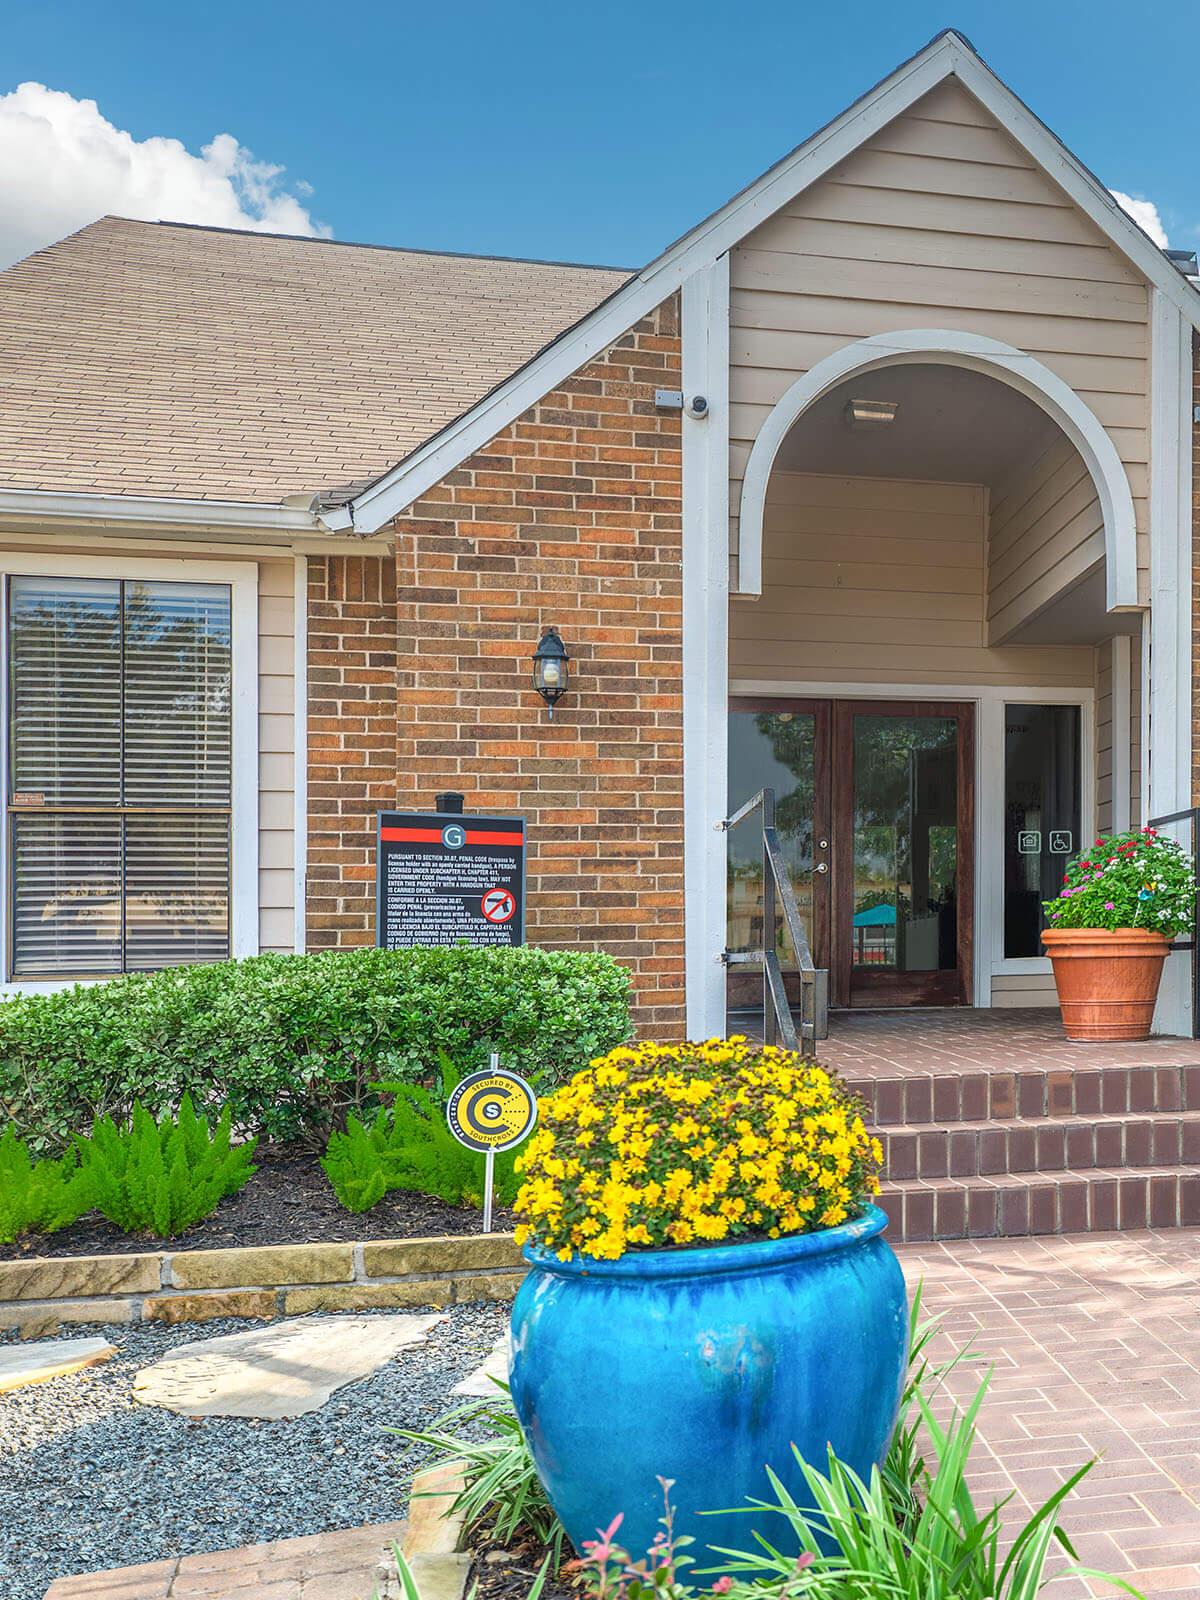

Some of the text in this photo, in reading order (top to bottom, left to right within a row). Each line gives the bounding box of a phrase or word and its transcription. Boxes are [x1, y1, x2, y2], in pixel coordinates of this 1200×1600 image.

[444, 827, 462, 846] G
[472, 1080, 515, 1092] SECURED BY
[486, 1104, 498, 1118] S
[469, 1130, 515, 1142] SOUTHCROSS
